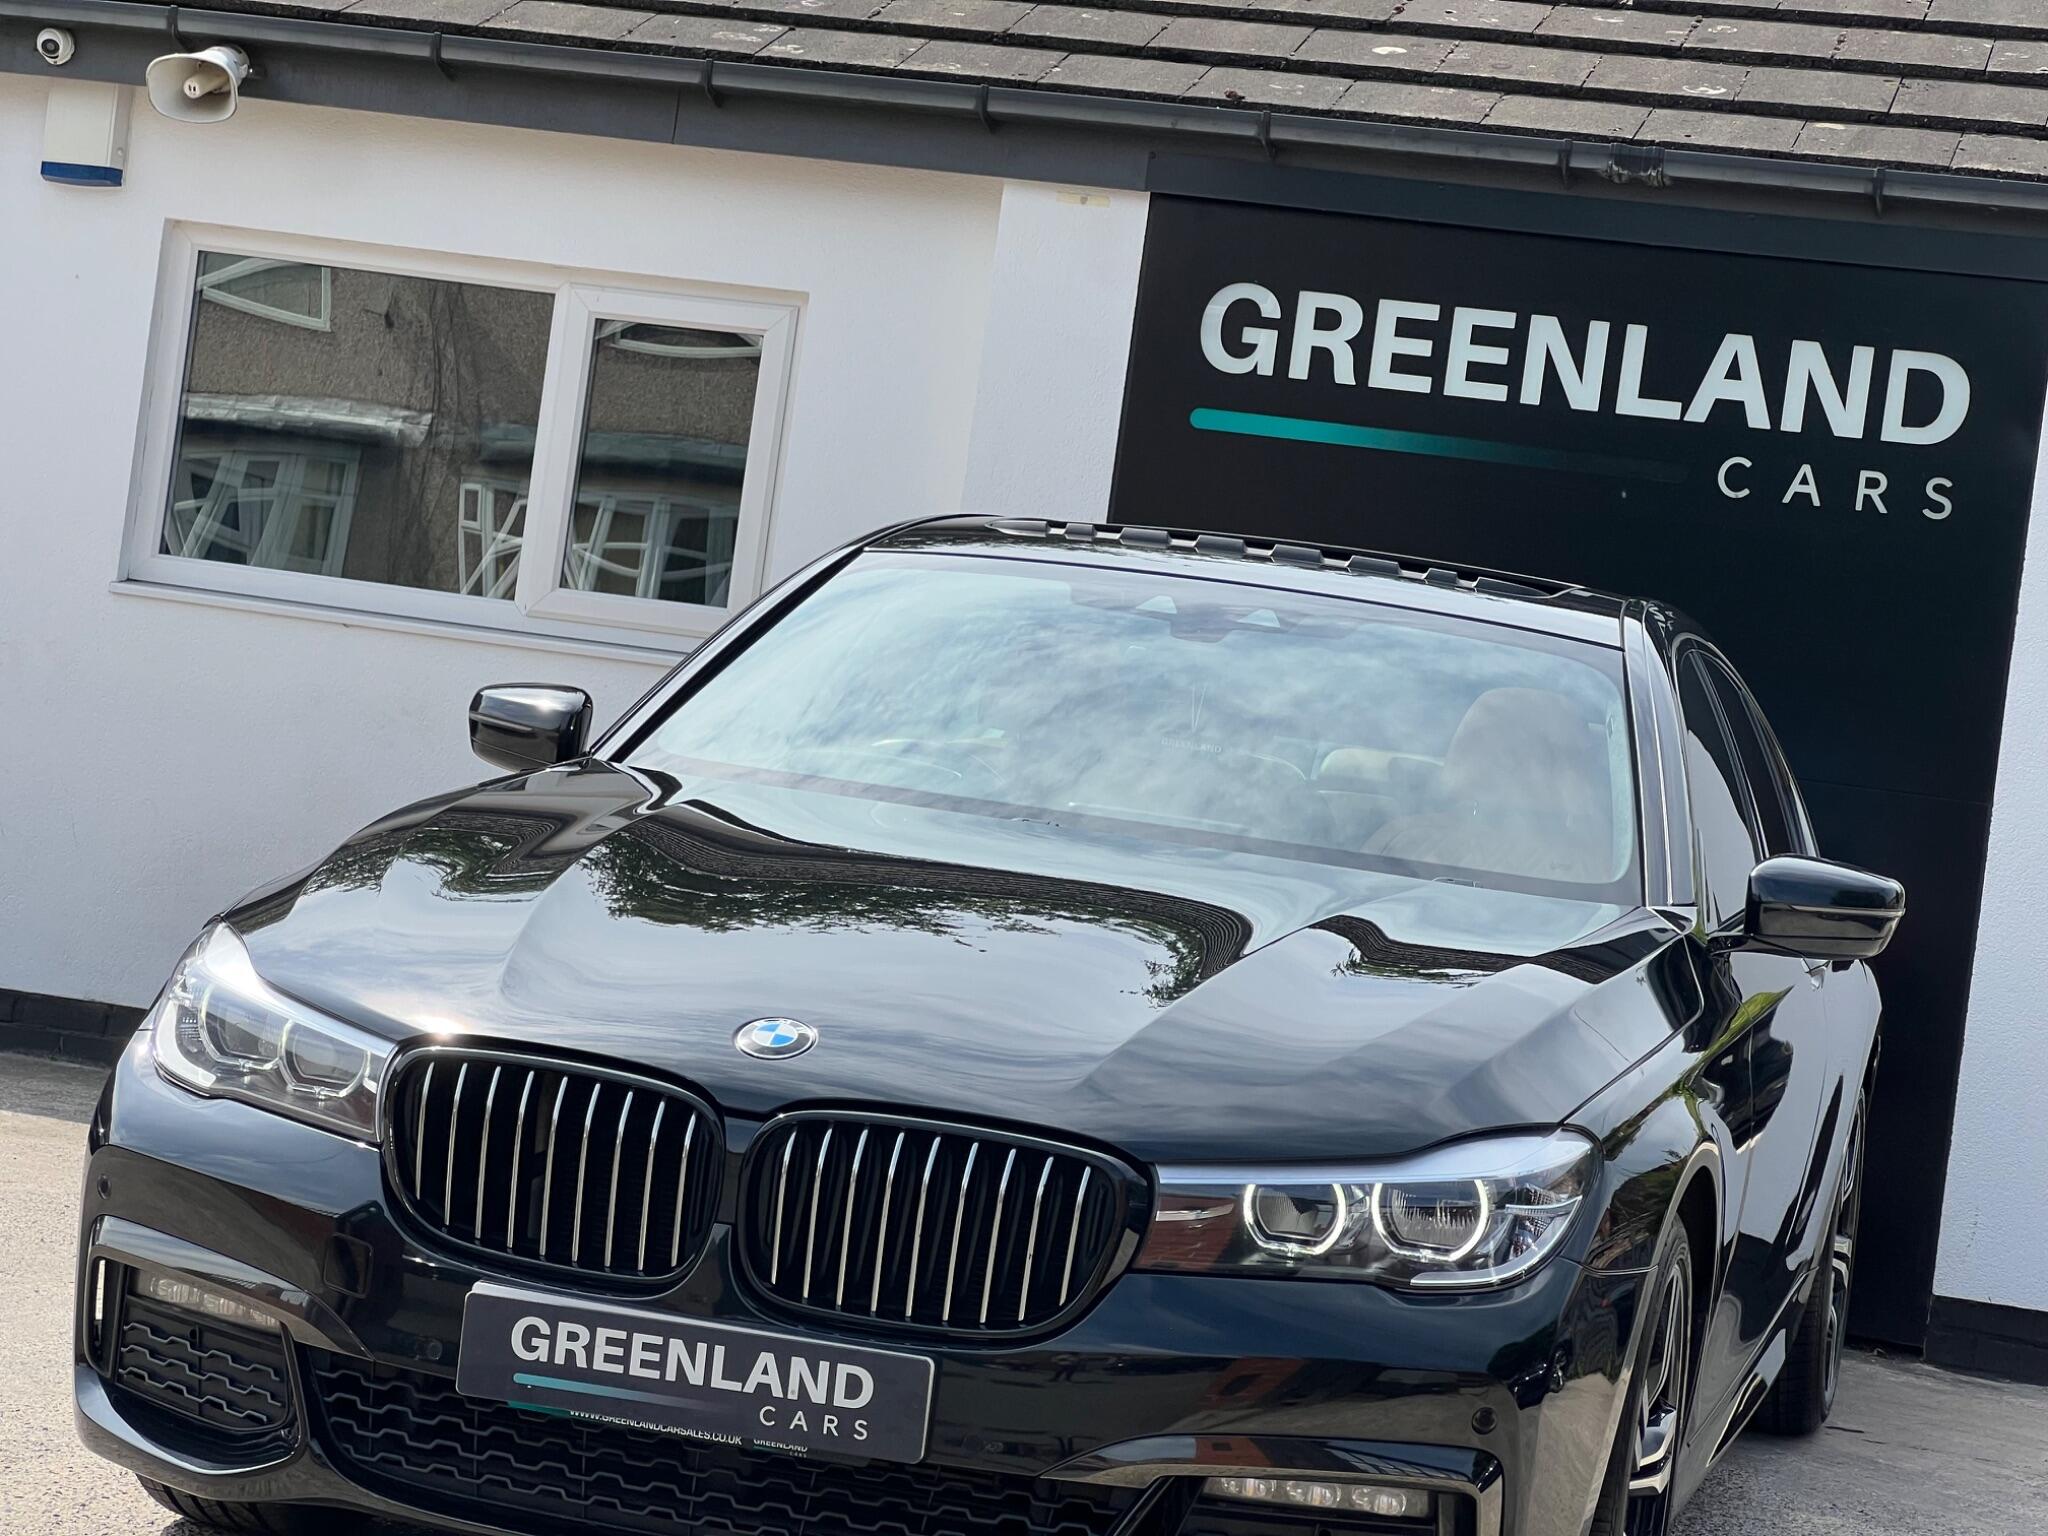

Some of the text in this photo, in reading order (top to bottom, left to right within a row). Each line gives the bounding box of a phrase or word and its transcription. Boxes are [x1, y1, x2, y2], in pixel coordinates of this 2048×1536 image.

[1199, 281, 1972, 446] GREENLAND
[1717, 455, 1954, 521] CARS
[510, 1316, 875, 1410] GREENLAND
[759, 1405, 869, 1441] CARS
